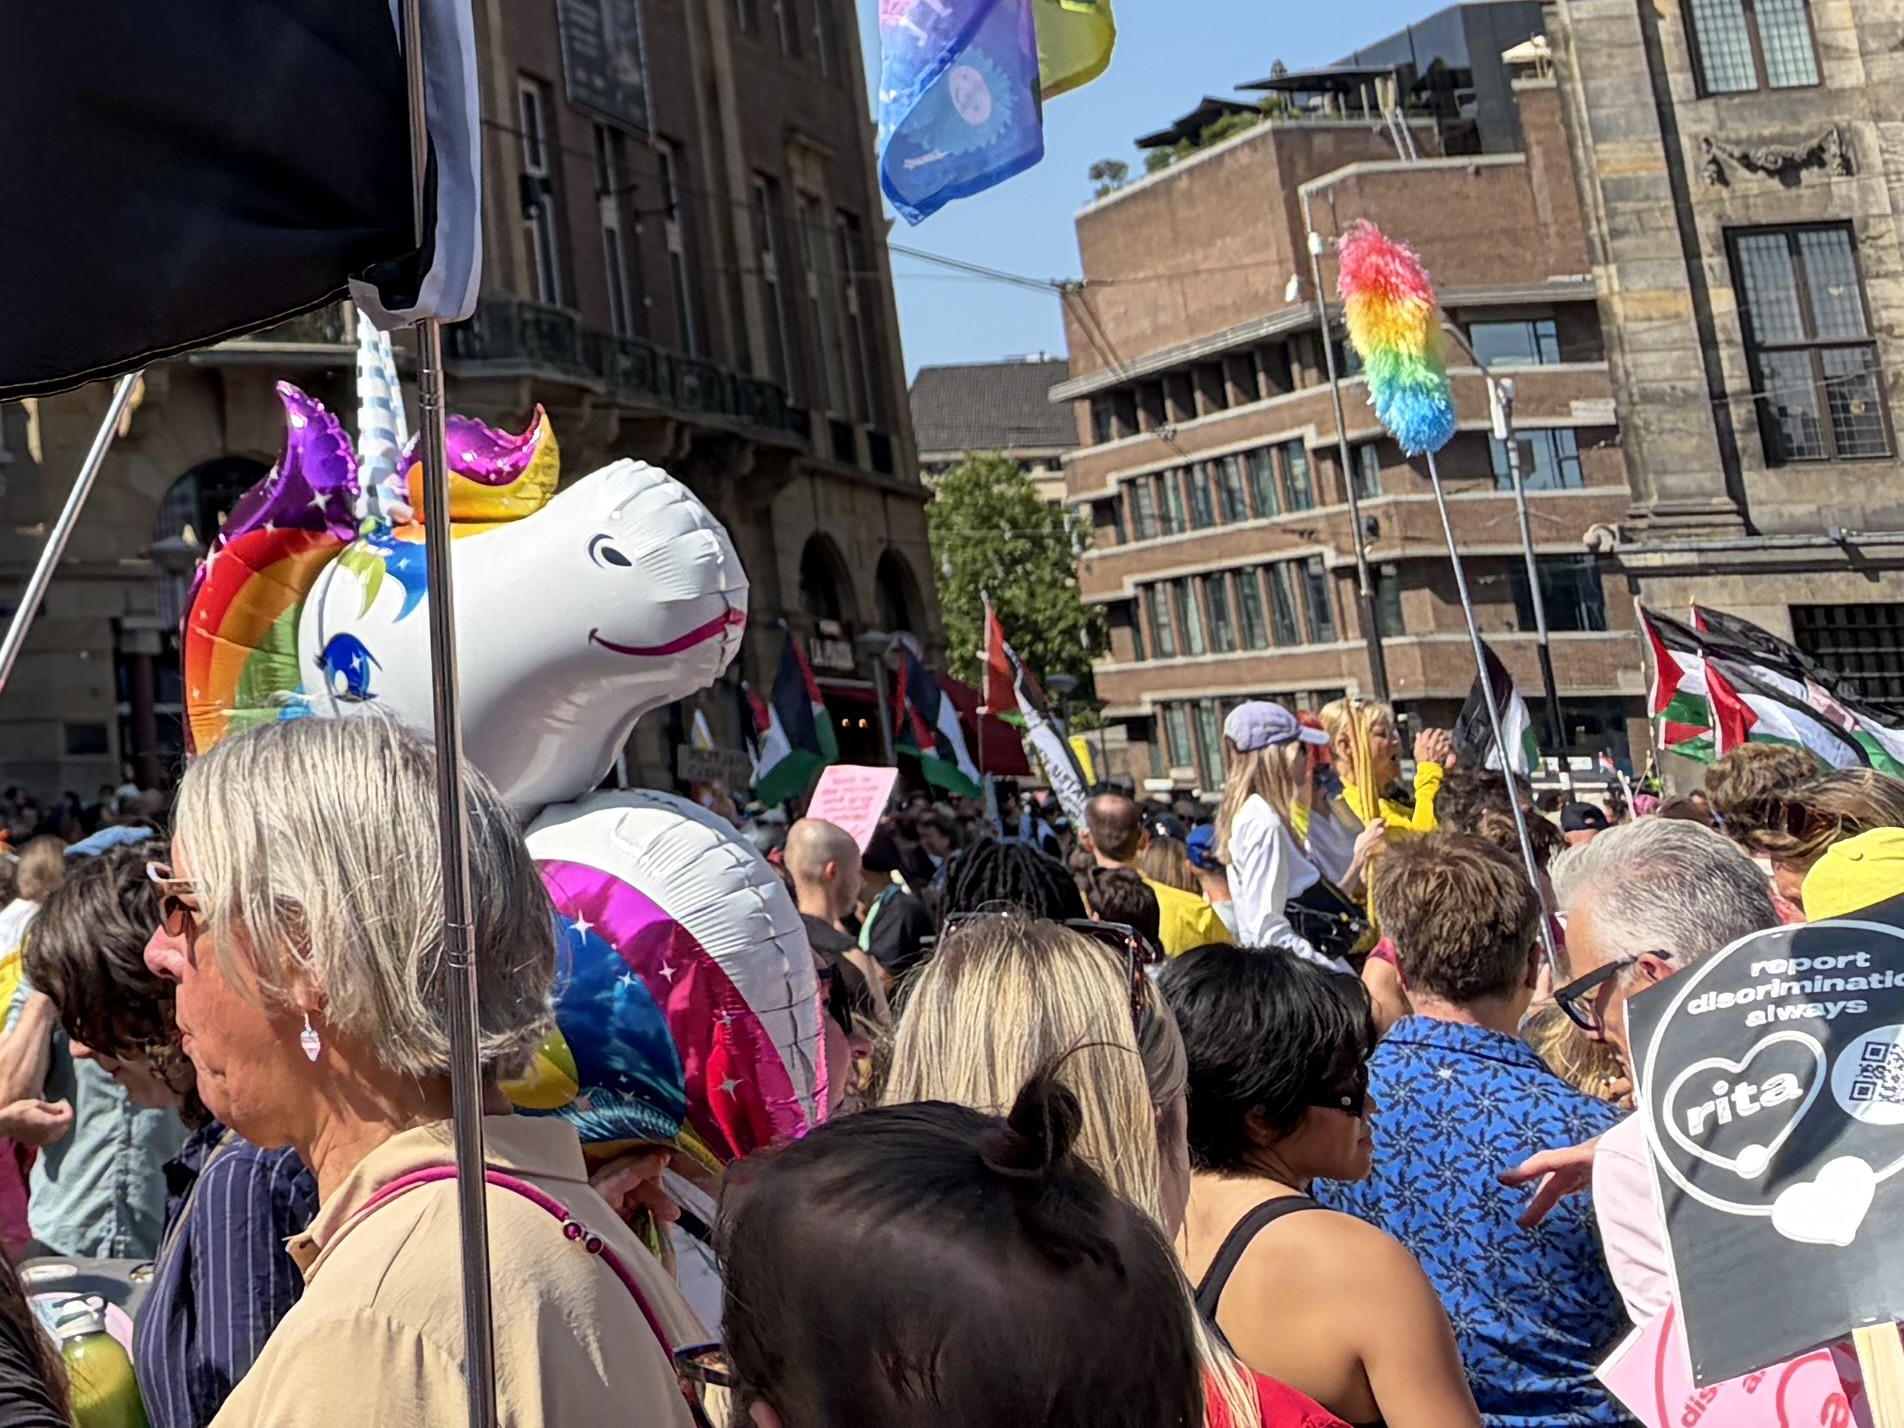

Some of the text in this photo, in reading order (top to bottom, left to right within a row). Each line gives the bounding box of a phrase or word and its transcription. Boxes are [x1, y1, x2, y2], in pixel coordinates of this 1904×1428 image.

[1750, 951, 1871, 977] report
[1745, 999, 1868, 1028] always
[1686, 1073, 1803, 1137] rita
